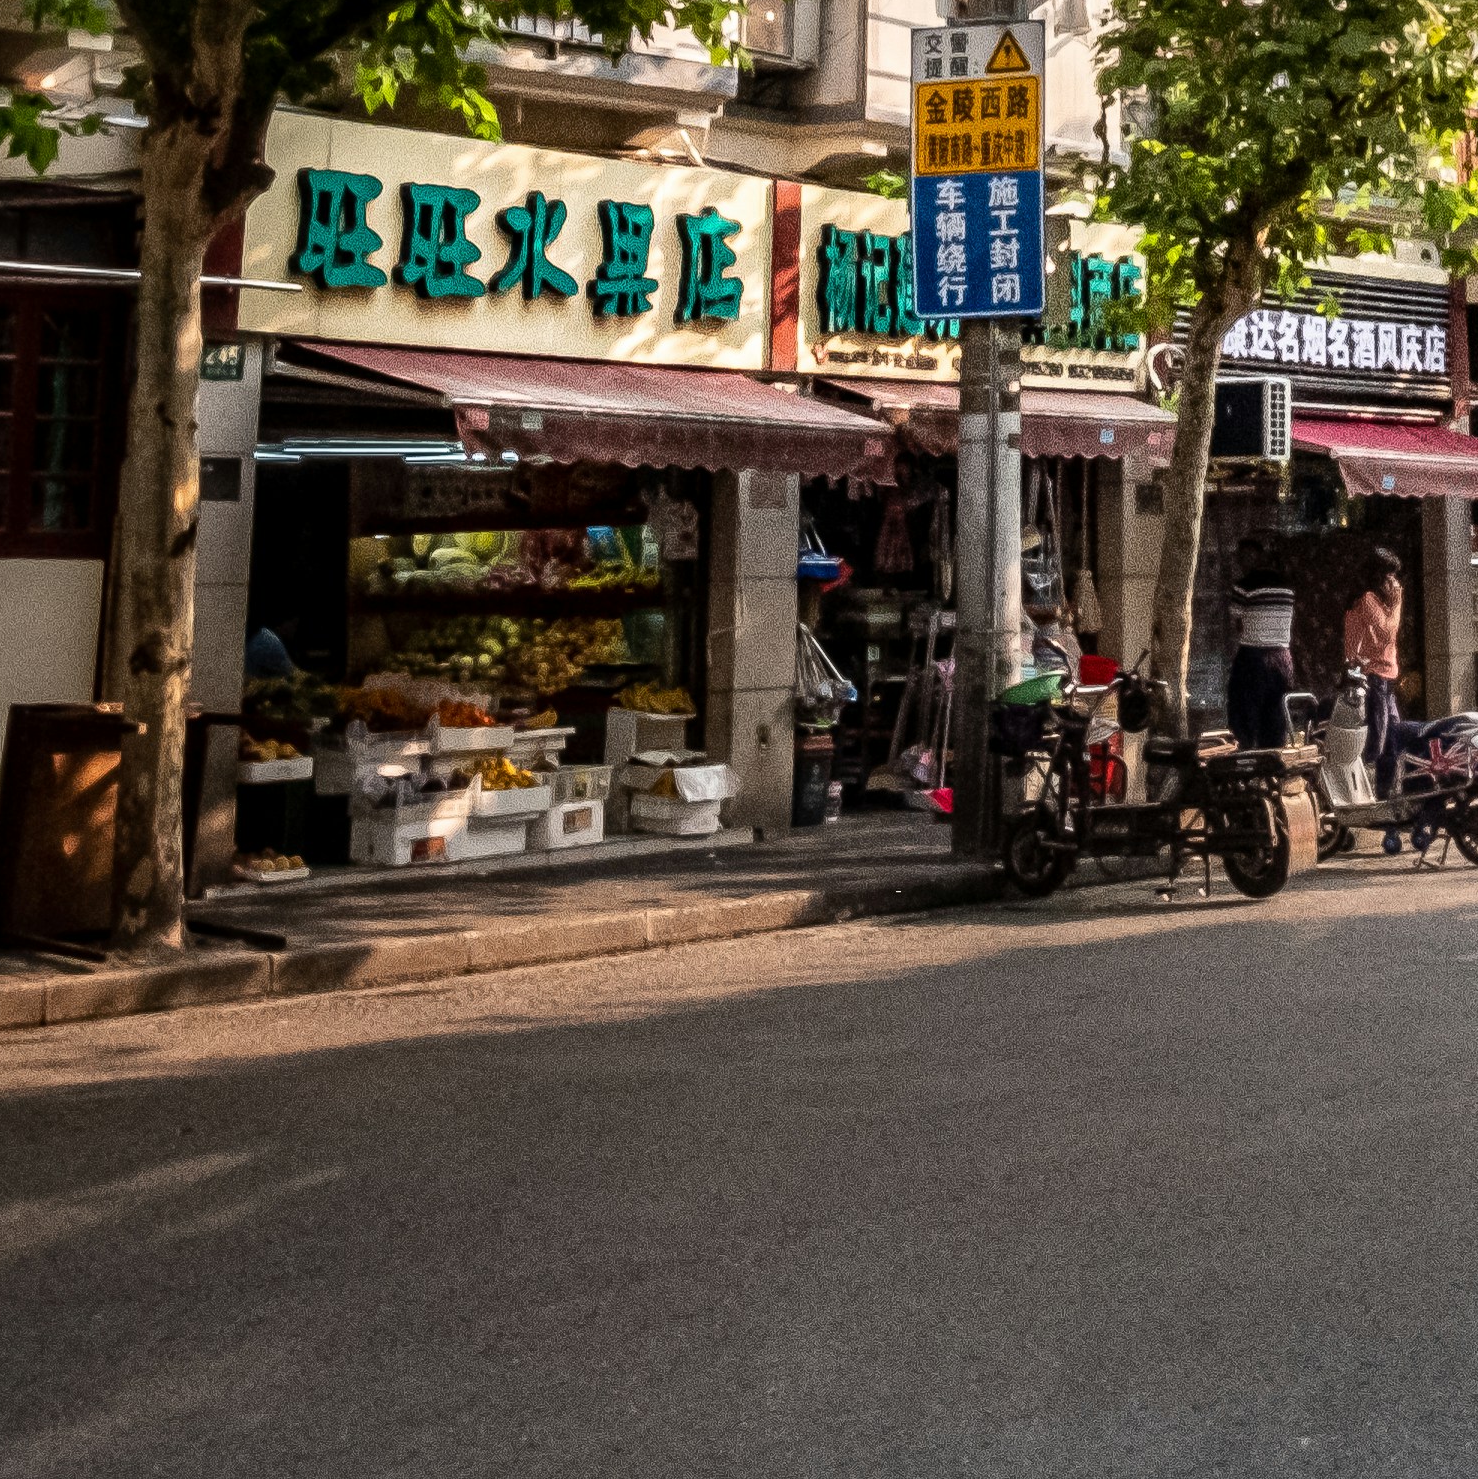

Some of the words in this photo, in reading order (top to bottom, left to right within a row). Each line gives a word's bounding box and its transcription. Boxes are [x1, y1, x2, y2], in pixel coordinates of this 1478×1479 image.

[925, 84, 1030, 125] 金陵西路
[292, 167, 745, 322] 旺旺水果店
[935, 178, 968, 307] 车辆绕行
[988, 176, 1022, 305] 施工封闭
